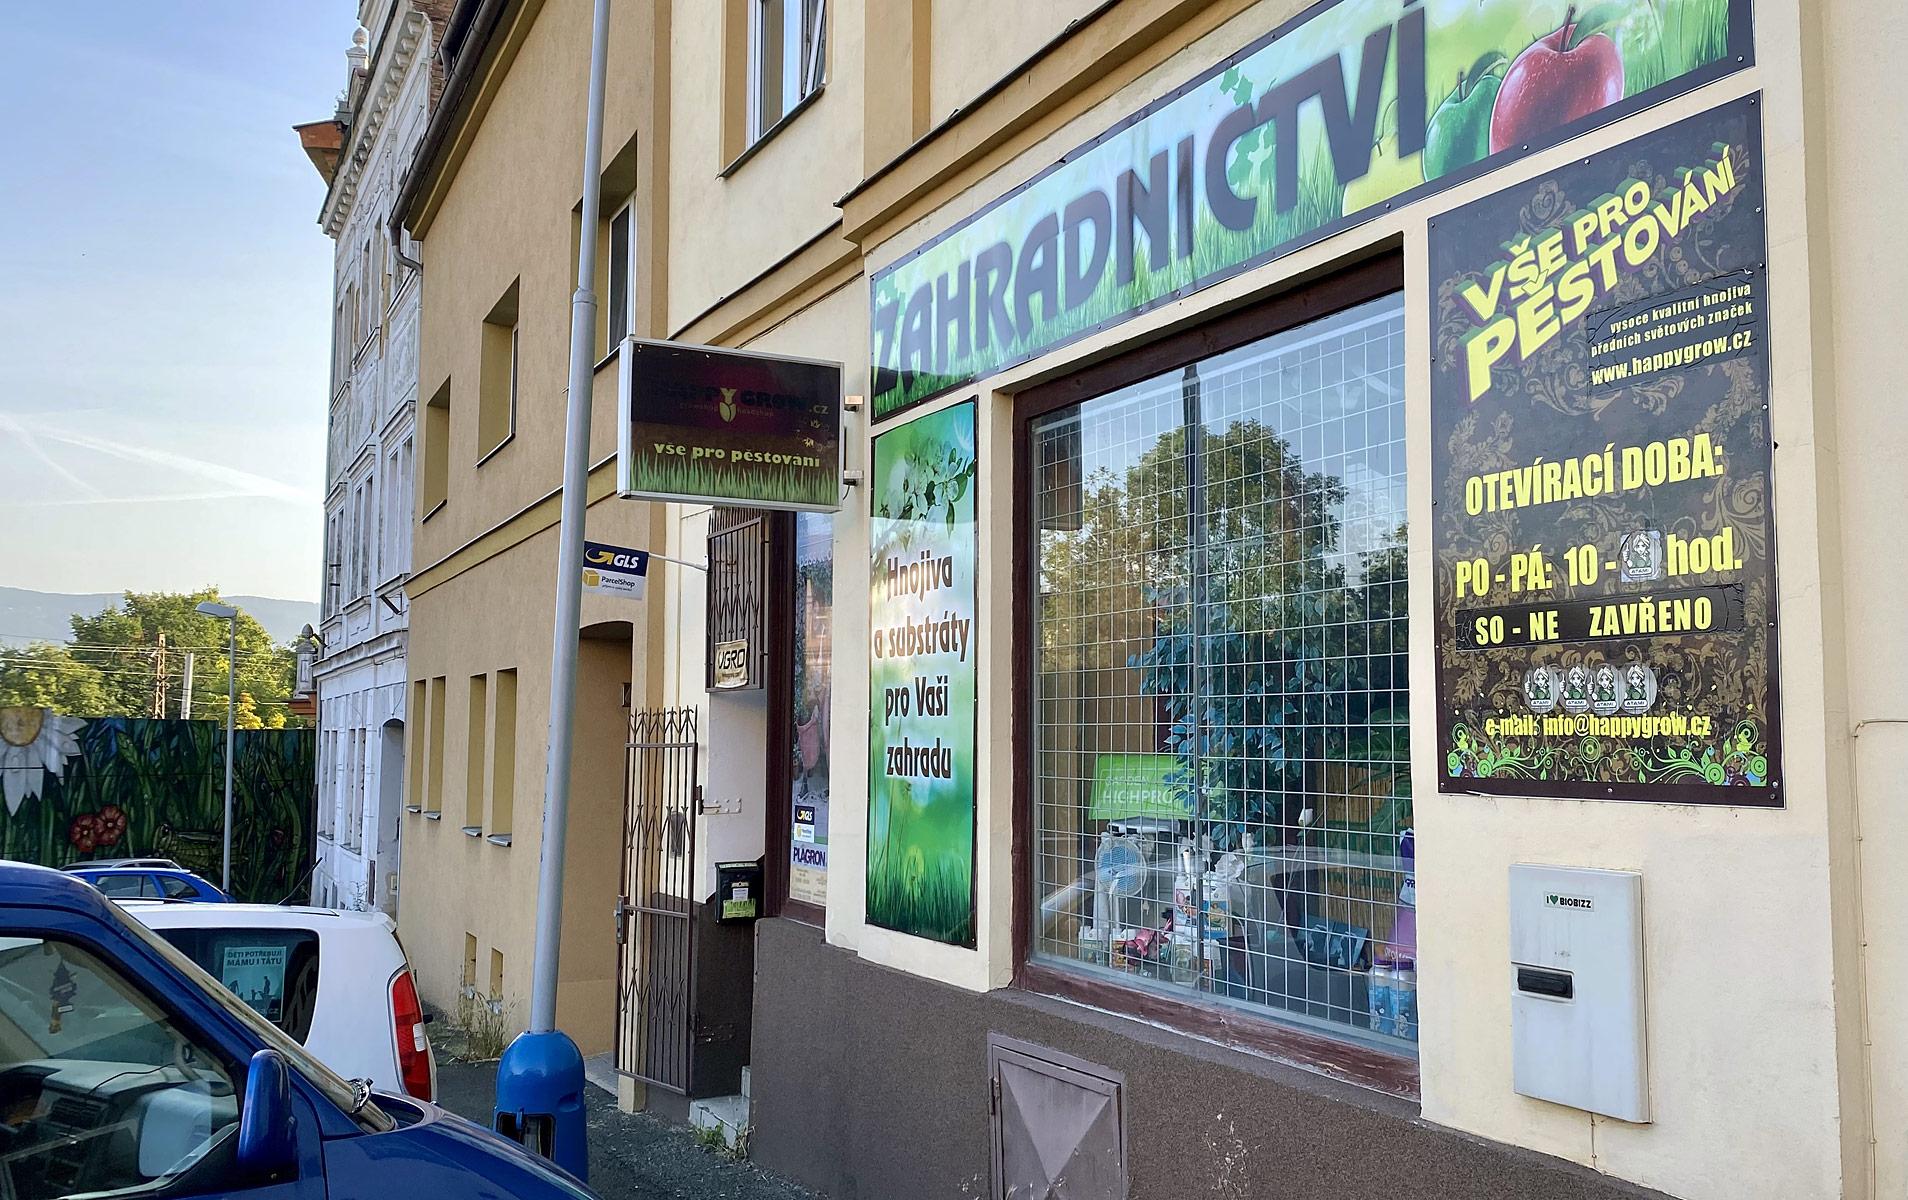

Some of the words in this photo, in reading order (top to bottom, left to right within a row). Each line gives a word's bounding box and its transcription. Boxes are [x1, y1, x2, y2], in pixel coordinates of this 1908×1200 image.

[875, 0, 1426, 397] ZAHRADNICTVÍ
[1459, 231, 1567, 322] VŠE
[1571, 178, 1652, 255] PRO
[1464, 143, 1737, 403] PĚSTOVÁNÍ
[1591, 332, 1641, 358] předních
[1644, 313, 1705, 342] světových
[1707, 301, 1753, 324] značek
[1610, 312, 1649, 335] vysoce
[1652, 296, 1700, 322] kvalitní
[1703, 284, 1751, 307] hnojiva
[1591, 329, 1752, 386] www.happygrow.cz
[692, 446, 726, 459] pro
[1465, 442, 1616, 516] OTEVÍRACÍ
[1621, 432, 1724, 491] DOBA:
[601, 576, 636, 588] ParcelShop
[613, 554, 640, 569] GLS
[887, 550, 953, 602] Hnojiva
[1456, 557, 1489, 598] PO
[1511, 544, 1553, 593] PÁ:
[1563, 544, 1598, 587] 10
[1666, 527, 1743, 577] hod.
[874, 627, 883, 659] a
[889, 611, 971, 662] substráty
[1475, 616, 1505, 645] SO
[1529, 611, 1560, 642] NE
[1589, 596, 1713, 637] ZAVŘENO
[885, 685, 910, 726] pro
[915, 675, 949, 717] Vaši
[1485, 714, 1538, 736] e-mail:
[1543, 713, 1711, 739] info@happygrow.cz
[886, 737, 952, 779] zahradu
[793, 846, 826, 867] PLAGRON
[1559, 897, 1592, 909] BIOBIZZ
